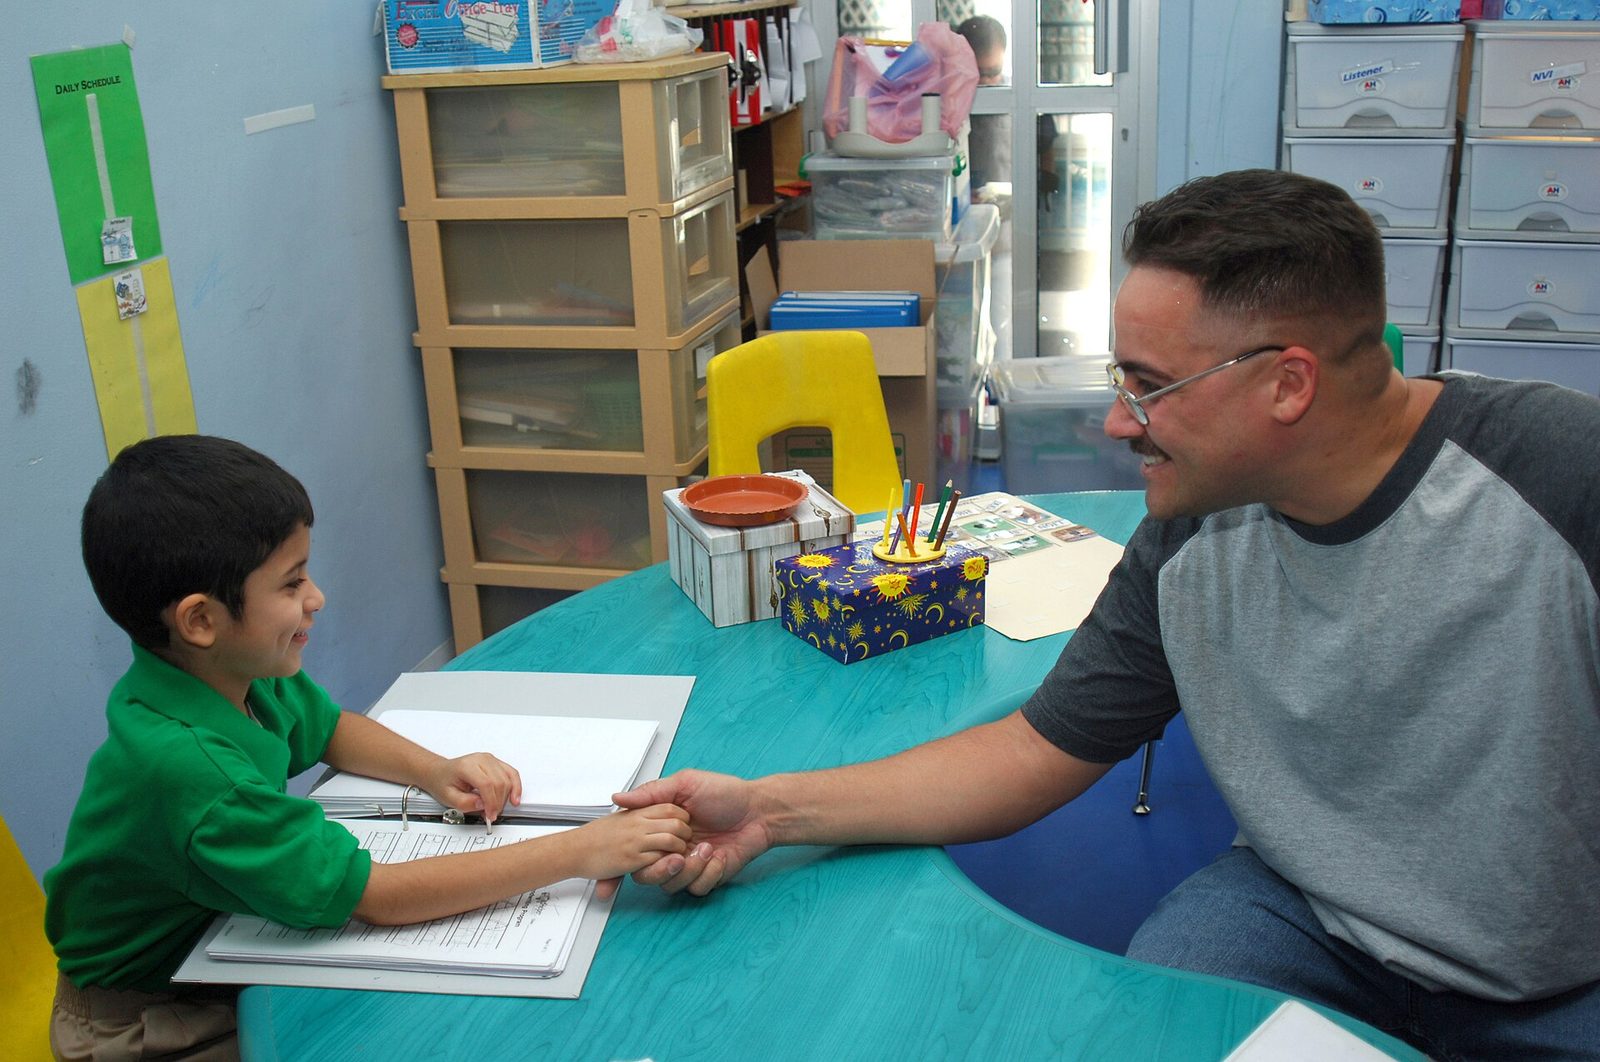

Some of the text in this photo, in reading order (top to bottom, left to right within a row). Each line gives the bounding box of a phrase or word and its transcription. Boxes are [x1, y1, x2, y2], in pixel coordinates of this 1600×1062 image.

[396, 0, 520, 20] EXCEL Office Tray
[1343, 66, 1383, 82] Listener
[55, 75, 121, 95] DAILY SCHEDULE
[1364, 80, 1377, 89] AH
[1558, 78, 1571, 86] AH
[1362, 180, 1375, 188] AH
[1546, 186, 1560, 194] AH
[1535, 283, 1548, 291] AH
